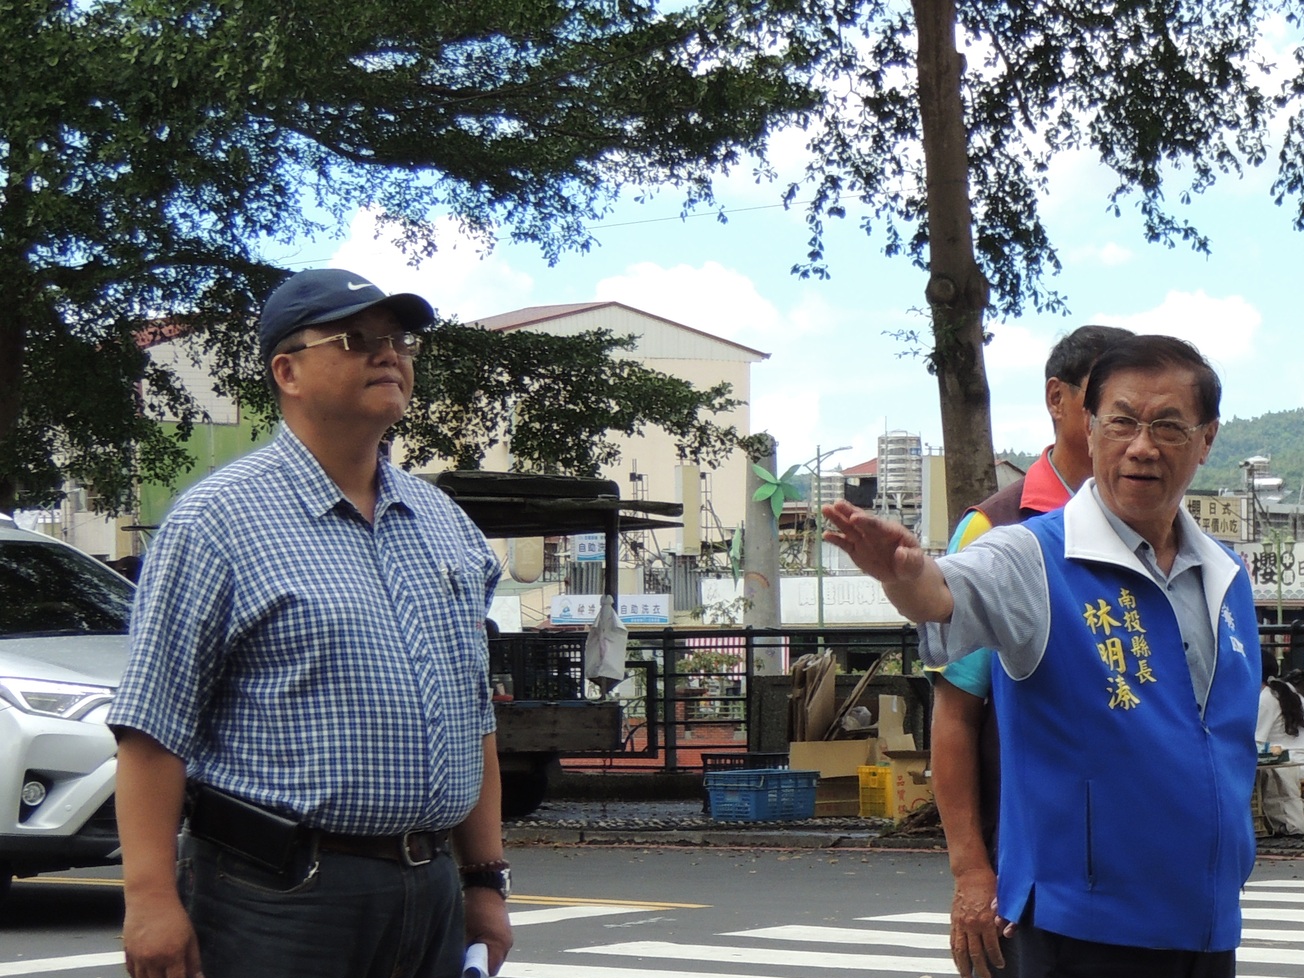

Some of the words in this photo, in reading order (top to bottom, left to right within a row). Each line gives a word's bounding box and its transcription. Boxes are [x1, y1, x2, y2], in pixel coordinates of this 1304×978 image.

[1209, 502, 1231, 516] 日式
[1202, 518, 1238, 533] 平價小吃
[1252, 551, 1278, 585] 櫻
[620, 604, 661, 614] 自助洗衣
[1118, 587, 1157, 684] 南投縣長
[1083, 598, 1141, 711] 林明溱
